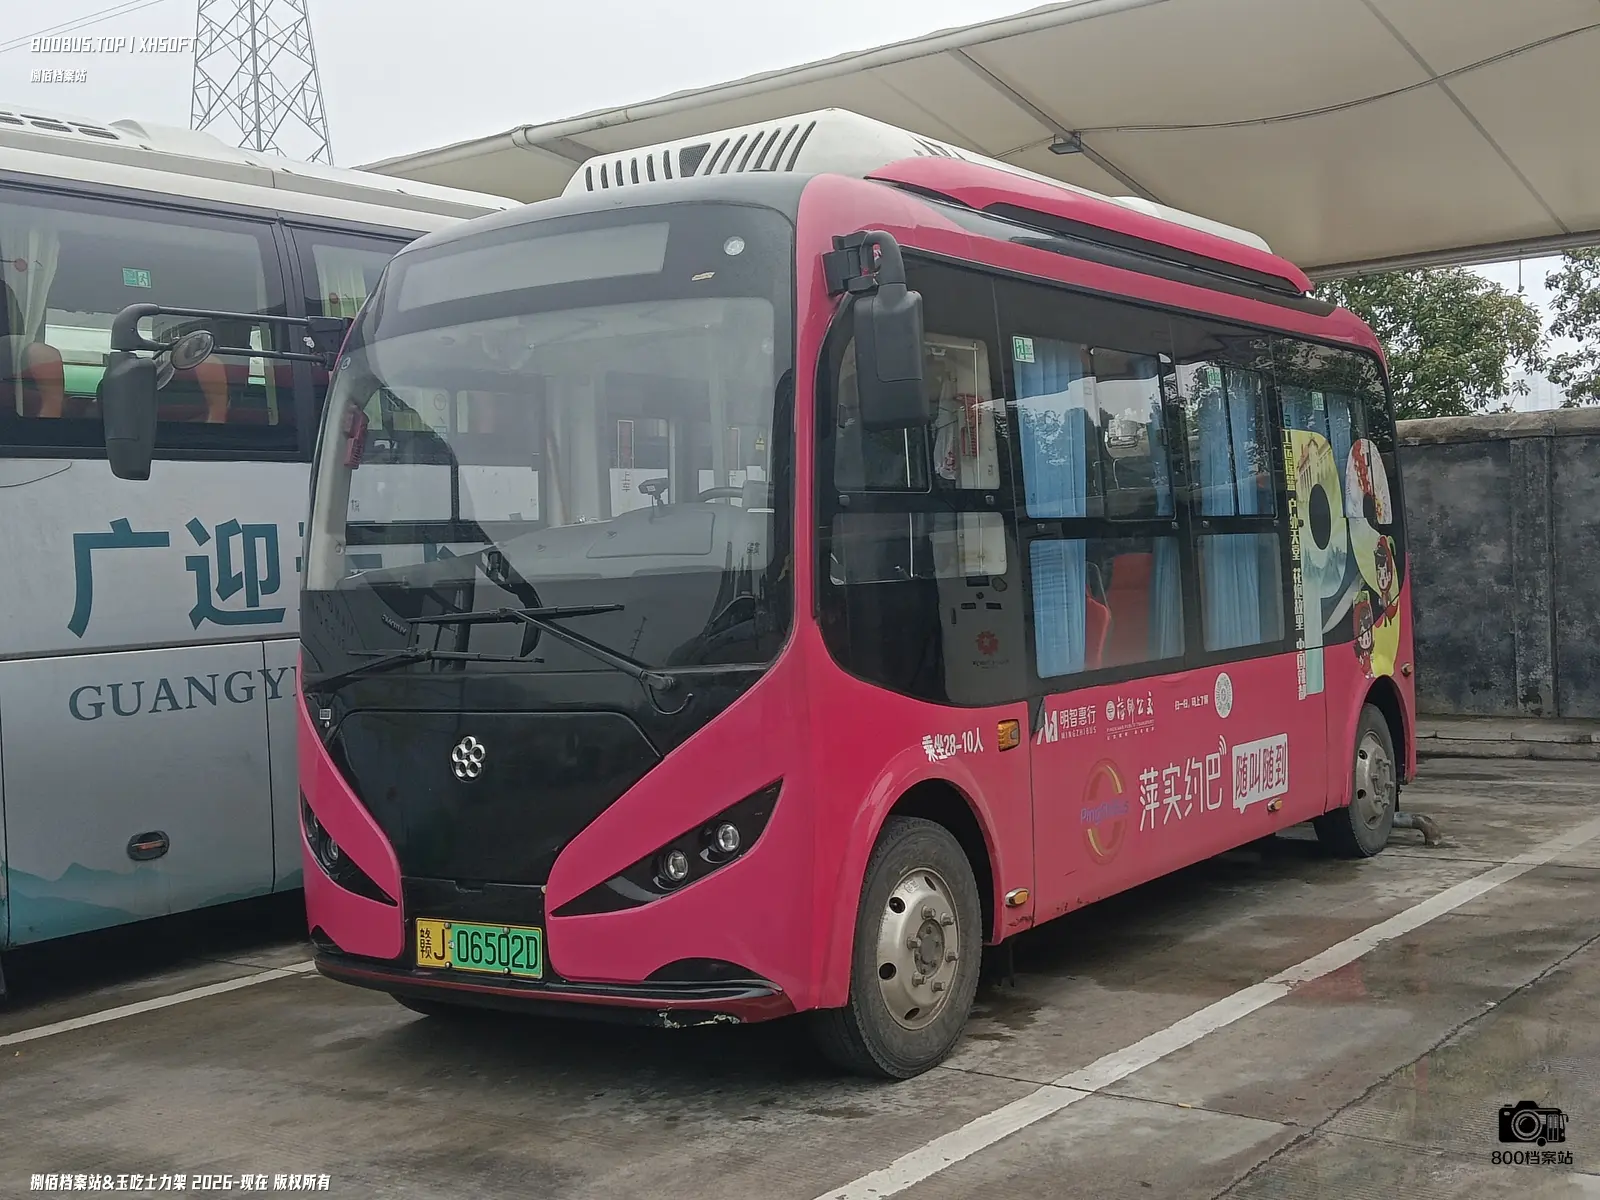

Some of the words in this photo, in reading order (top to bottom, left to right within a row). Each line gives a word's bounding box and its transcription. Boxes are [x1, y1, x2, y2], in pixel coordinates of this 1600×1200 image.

[67, 516, 305, 640] 广迎
[1060, 705, 1097, 730] 明智惠行
[1138, 752, 1223, 832] 萍实约巴
[1235, 742, 1287, 799] 随叫随到
